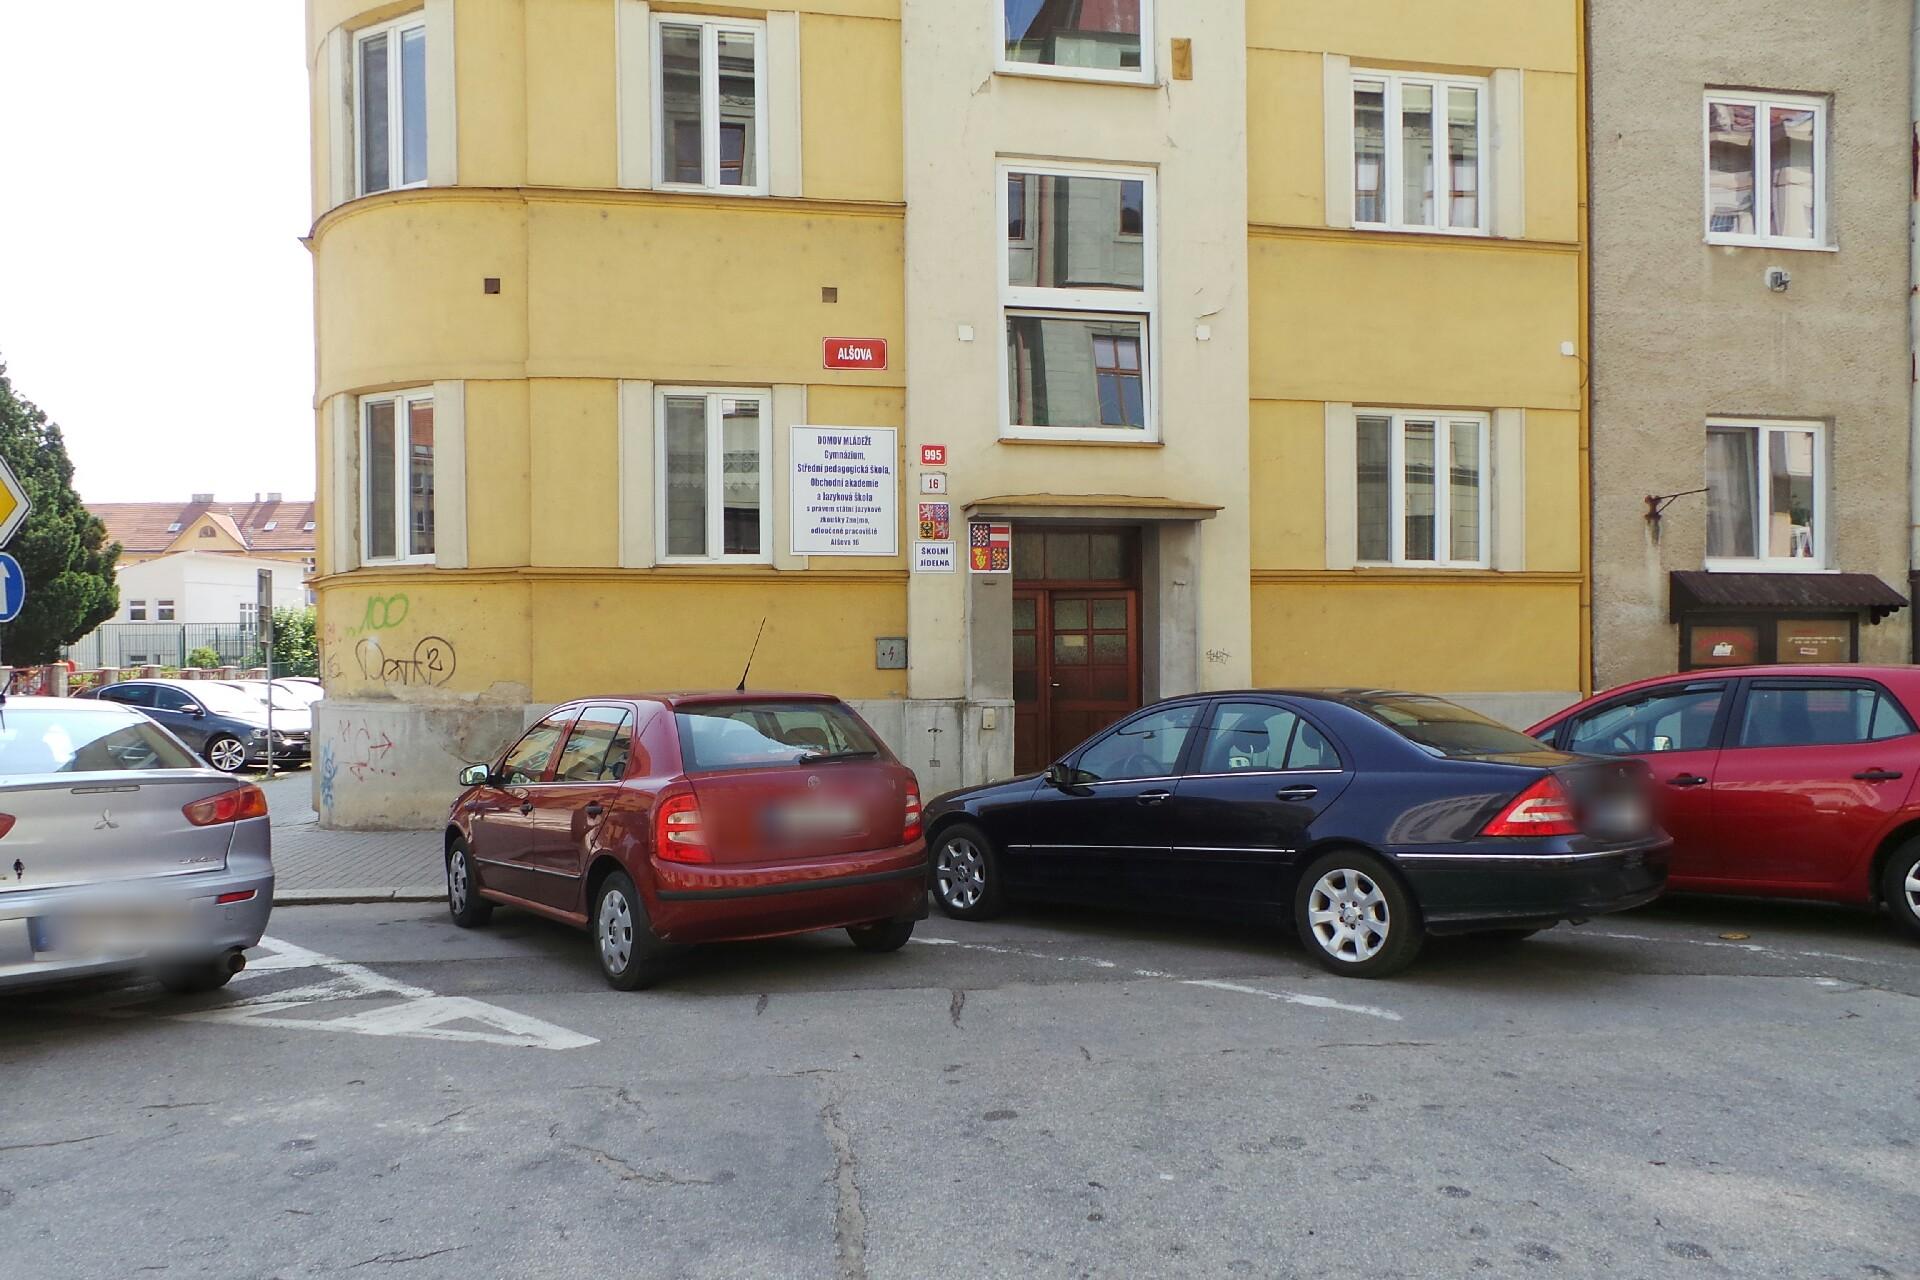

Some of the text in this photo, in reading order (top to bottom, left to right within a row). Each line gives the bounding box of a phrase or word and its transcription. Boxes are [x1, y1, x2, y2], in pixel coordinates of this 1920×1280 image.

[837, 344, 873, 361] ALŠOVA
[817, 435, 872, 446] DOMOV MLÁDEŽE
[824, 449, 866, 461] Gymnázium,
[924, 449, 942, 461] 995
[797, 463, 891, 475] Střední pedagogická škola,
[810, 477, 879, 488] Obchodní akademie
[928, 478, 939, 488] 16
[816, 493, 822, 501] a
[854, 492, 873, 502] škola
[811, 505, 835, 513] právem
[810, 527, 878, 536] odloučené pracoviště
[921, 546, 949, 555] ŠKOLNÍ
[920, 558, 950, 567] JÍDELNA
